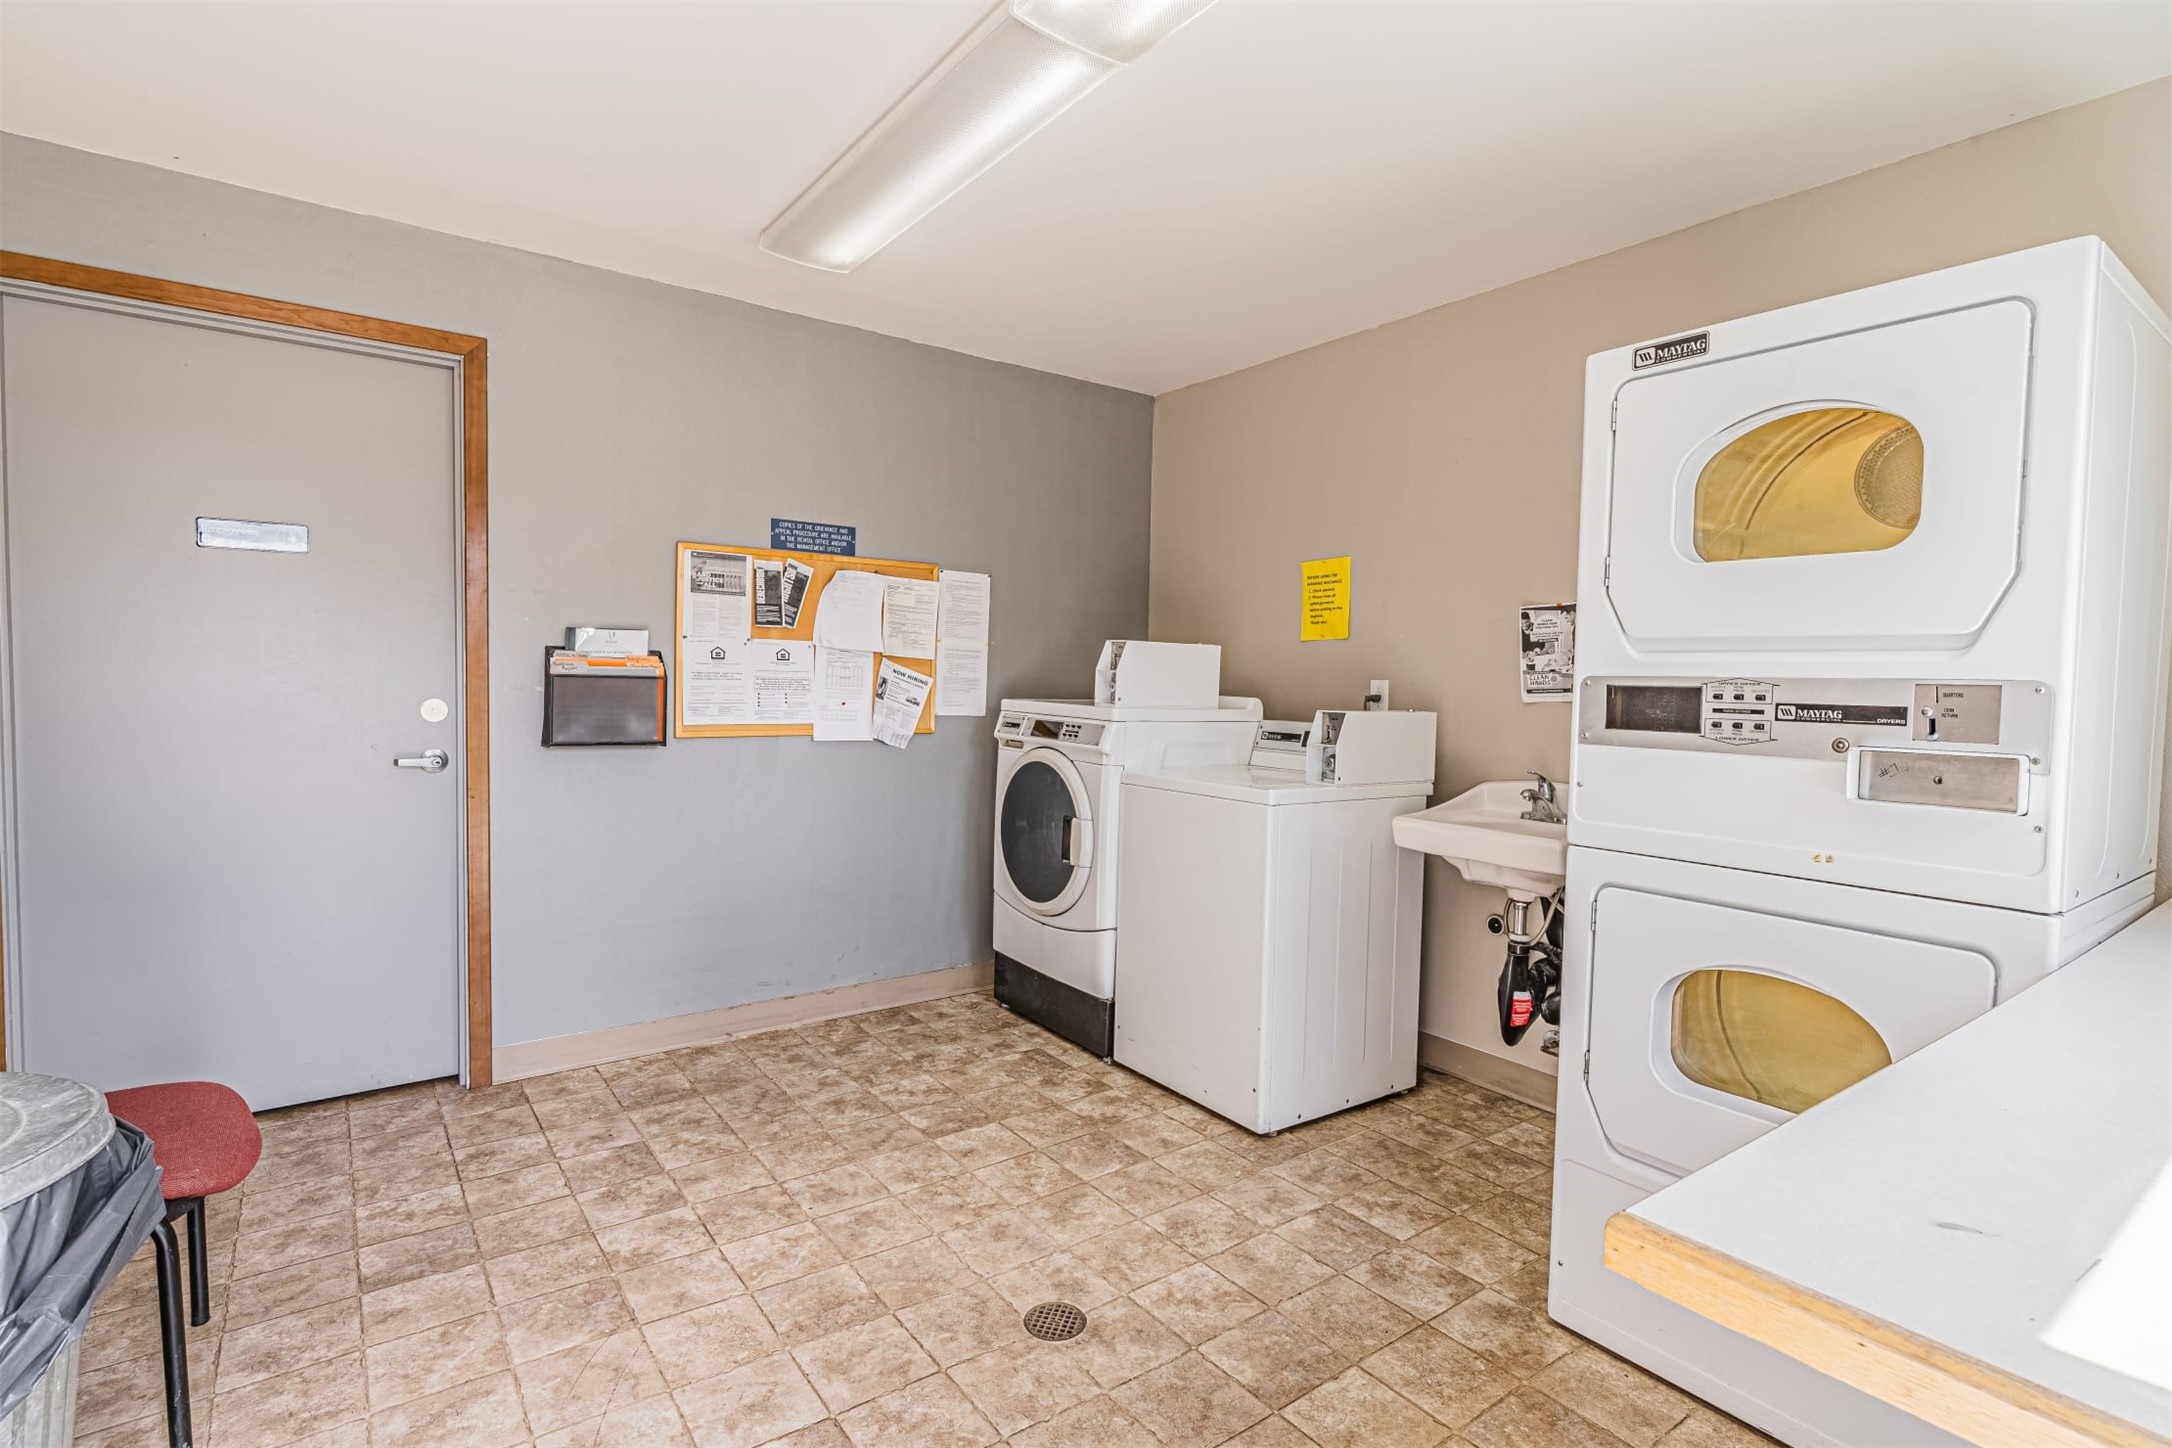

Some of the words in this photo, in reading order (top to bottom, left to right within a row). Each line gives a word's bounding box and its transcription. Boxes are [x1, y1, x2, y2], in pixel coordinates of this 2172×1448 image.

[1656, 349, 1705, 363] COMMERCIAL
[1657, 339, 1705, 358] MAYTAG
[893, 668, 906, 677] NOW
[907, 674, 929, 686] HIRING
[1796, 709, 1842, 719] MAYTAG
